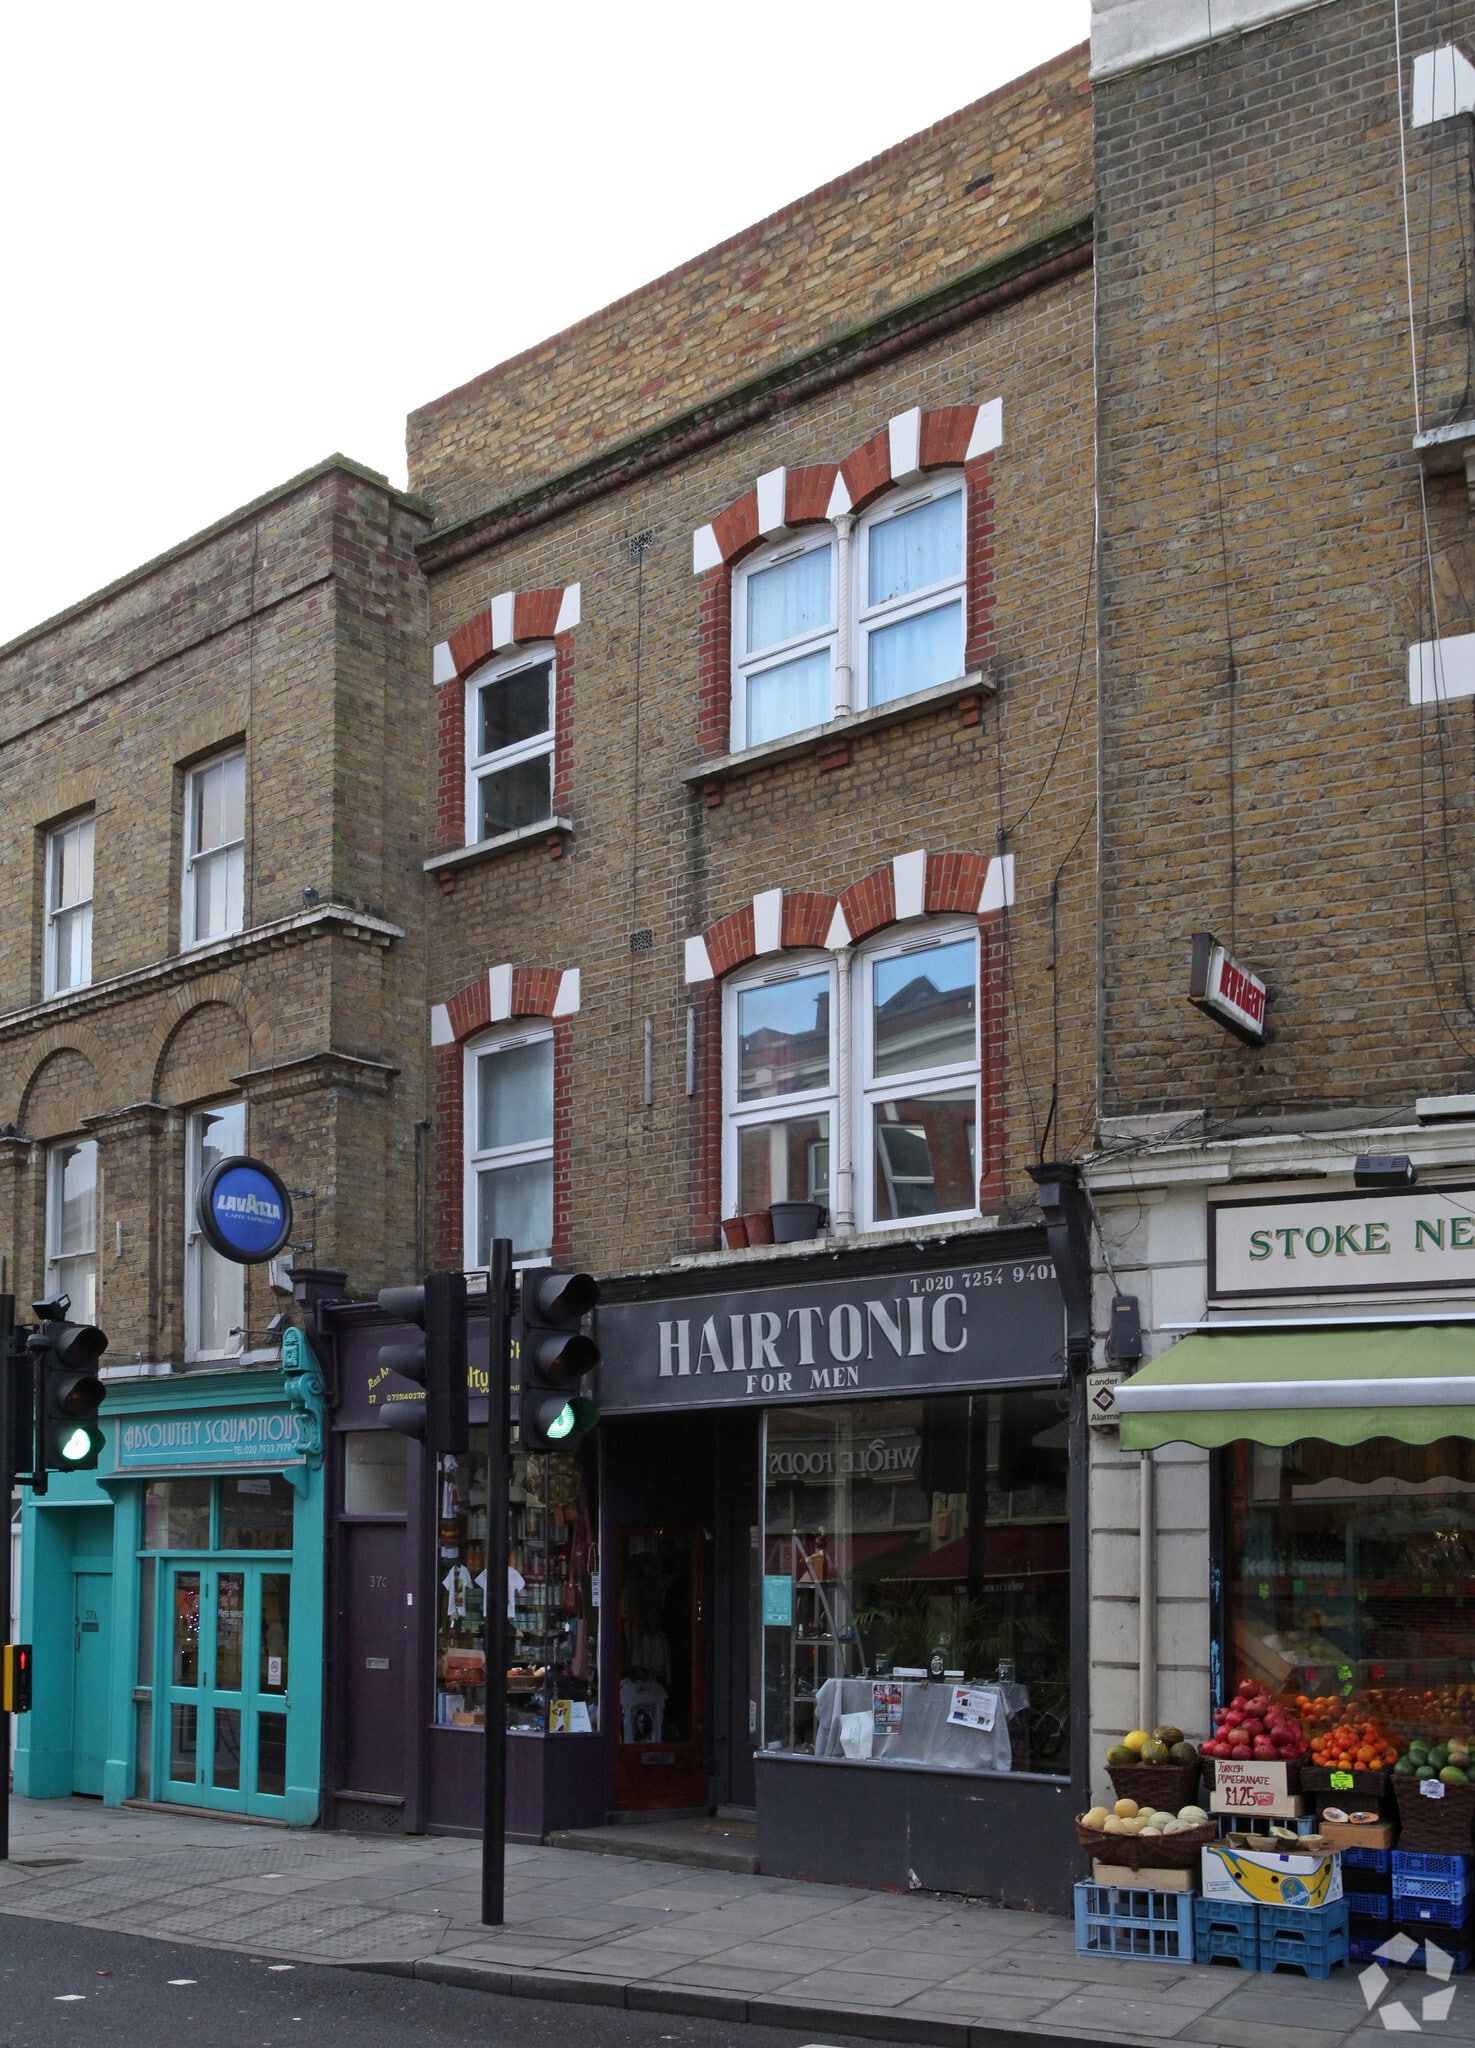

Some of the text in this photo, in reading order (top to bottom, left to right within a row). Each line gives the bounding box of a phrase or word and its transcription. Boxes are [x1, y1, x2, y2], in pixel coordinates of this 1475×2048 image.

[1220, 959, 1265, 1025] NEWSAGENT
[217, 1193, 281, 1220] LAVAZZA
[1250, 1216, 1475, 1261] STOKE NE
[910, 1263, 1058, 1293] T.020 7254 9401
[658, 1293, 968, 1377] HAIRTONIC
[746, 1366, 860, 1394] FOR MEN
[1089, 1377, 1118, 1386] Lander
[1091, 1413, 1120, 1421] Alarms
[124, 1414, 300, 1452] ABSOLUTELY SCRUMPTIOUS
[1217, 1774, 1270, 1785] POMEGRANATE
